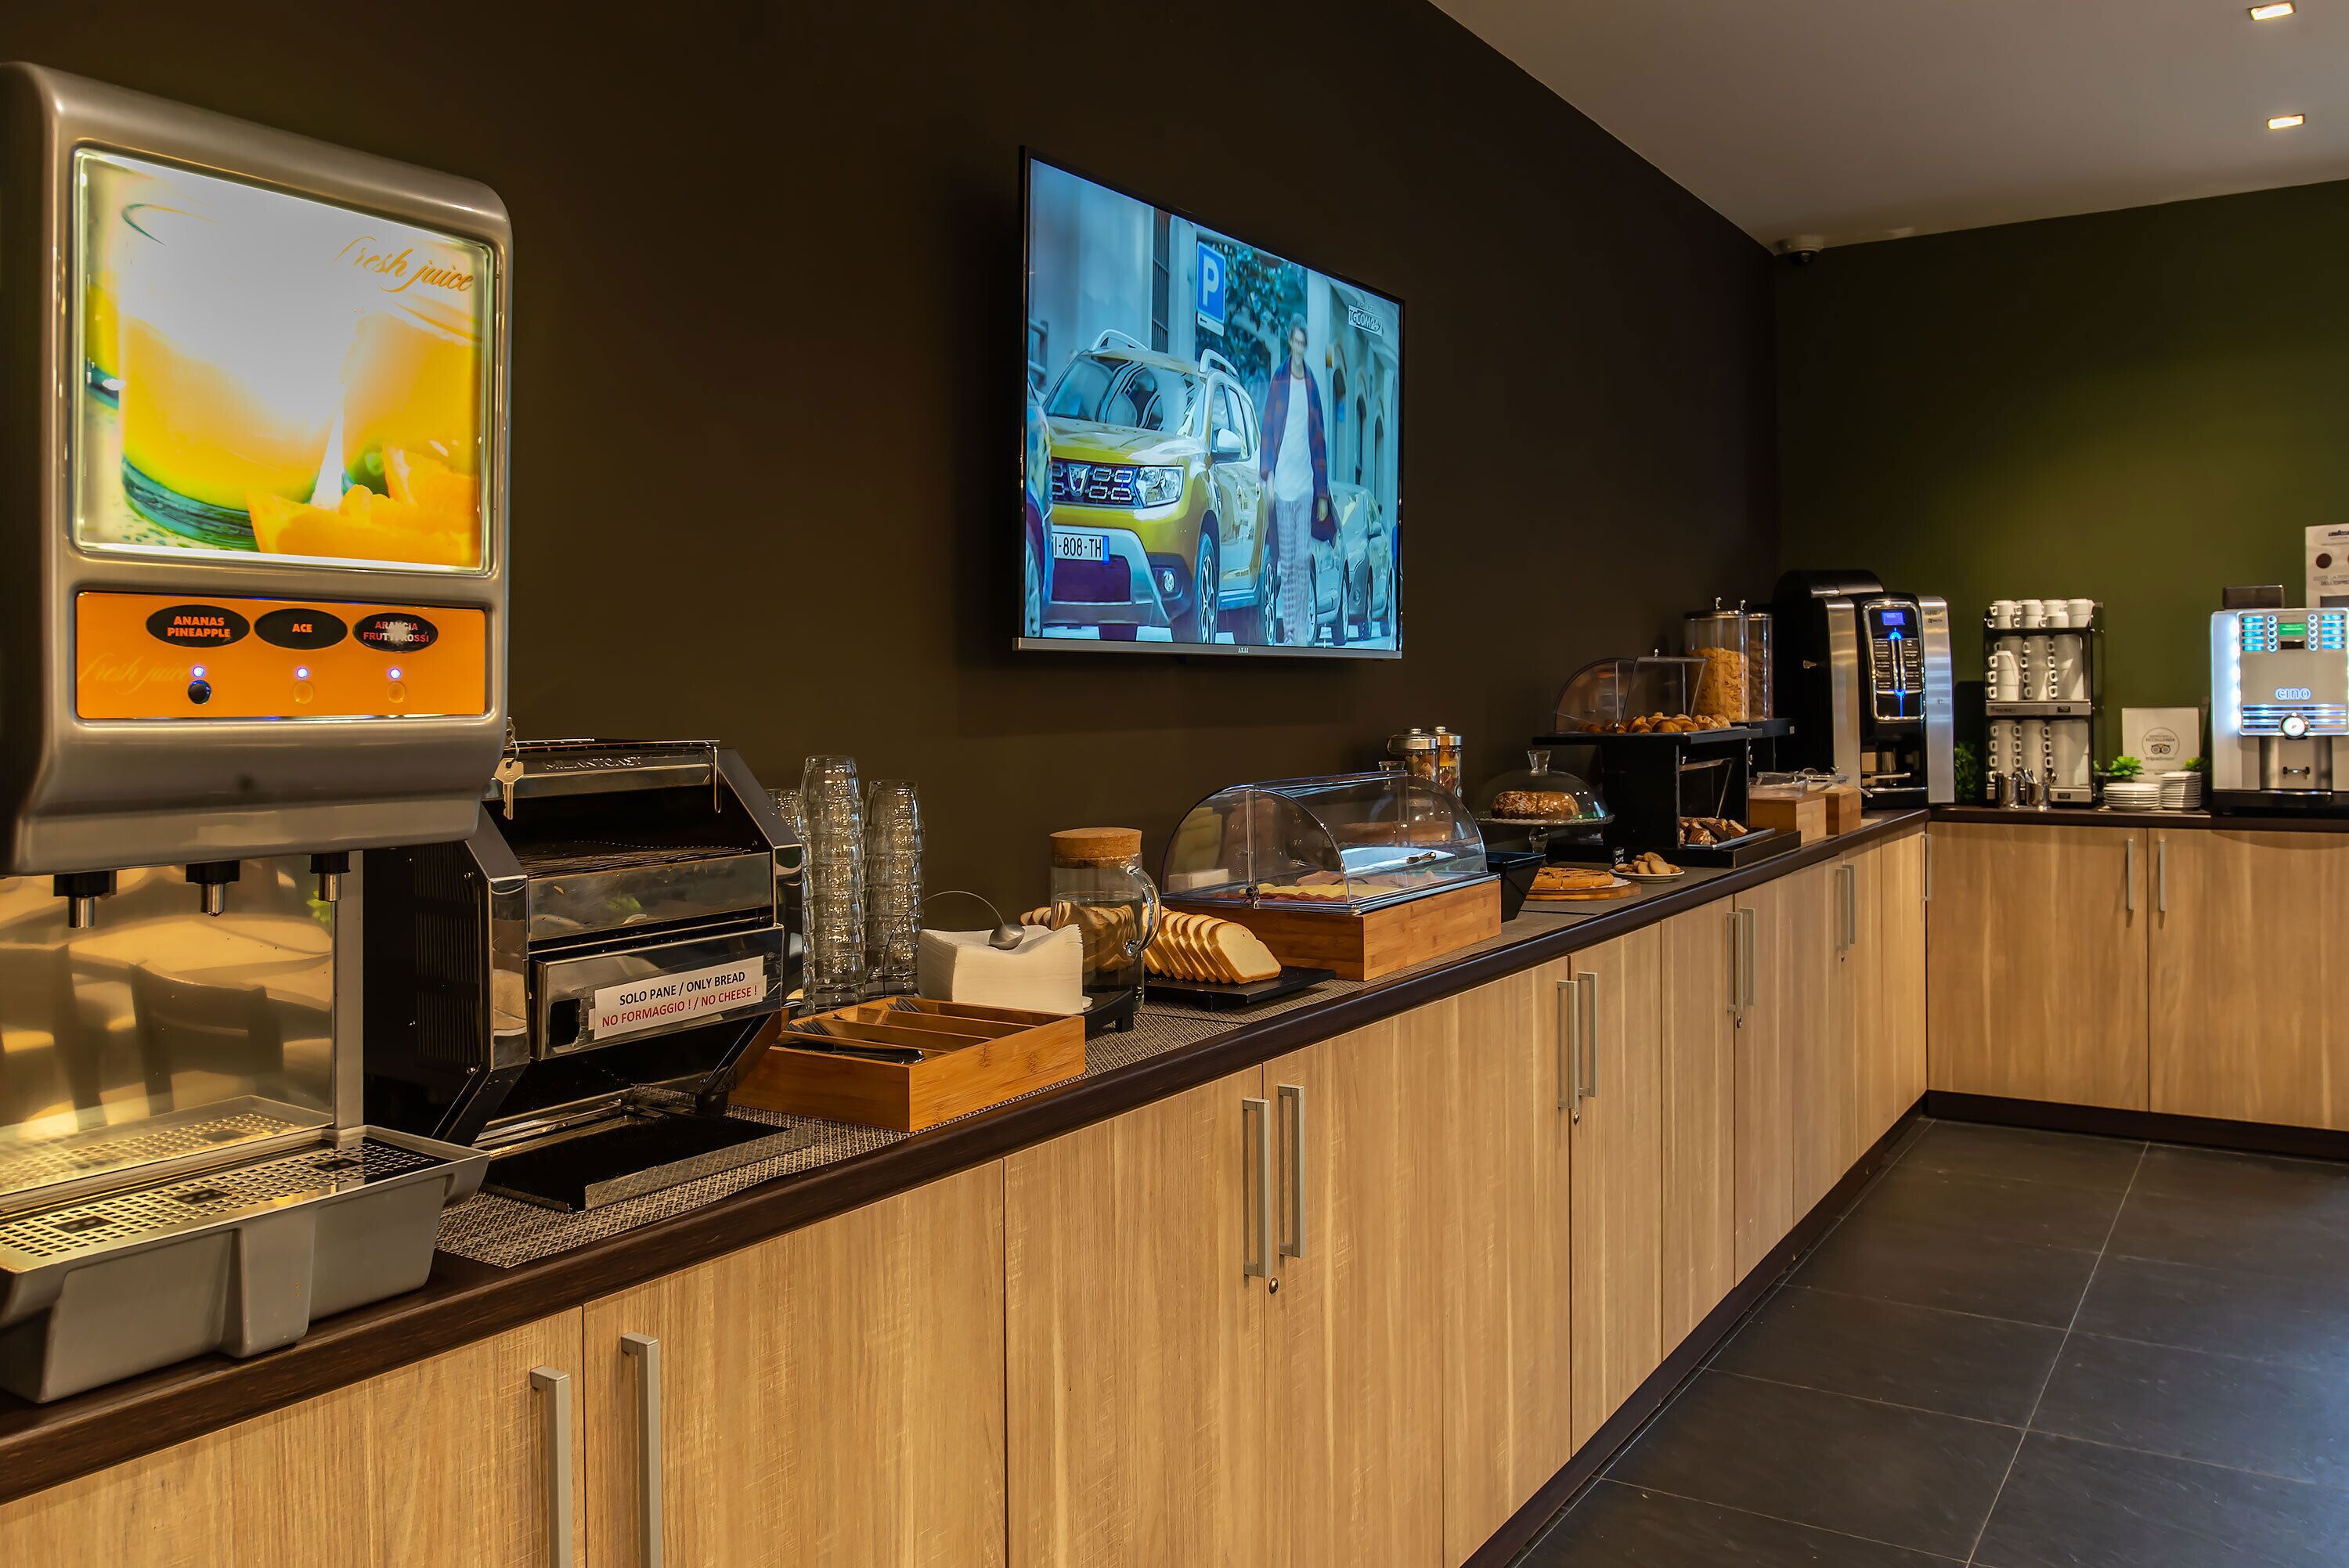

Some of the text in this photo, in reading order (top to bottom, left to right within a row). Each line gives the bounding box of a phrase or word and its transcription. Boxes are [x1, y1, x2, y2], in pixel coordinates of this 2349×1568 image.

[377, 259, 474, 292] juice
[1203, 253, 1220, 308] P
[167, 627, 231, 638] PINEAPPLE
[173, 616, 225, 626] ANANAS
[291, 624, 312, 633] ACE
[619, 971, 745, 1006] SOLO PANE / ONLY BREAD
[602, 1014, 619, 1027] NO
[621, 1001, 685, 1022] FORMAGGIO
[693, 997, 698, 1011] /
[701, 994, 716, 1007] NO
[718, 986, 752, 1003] CHEESE
